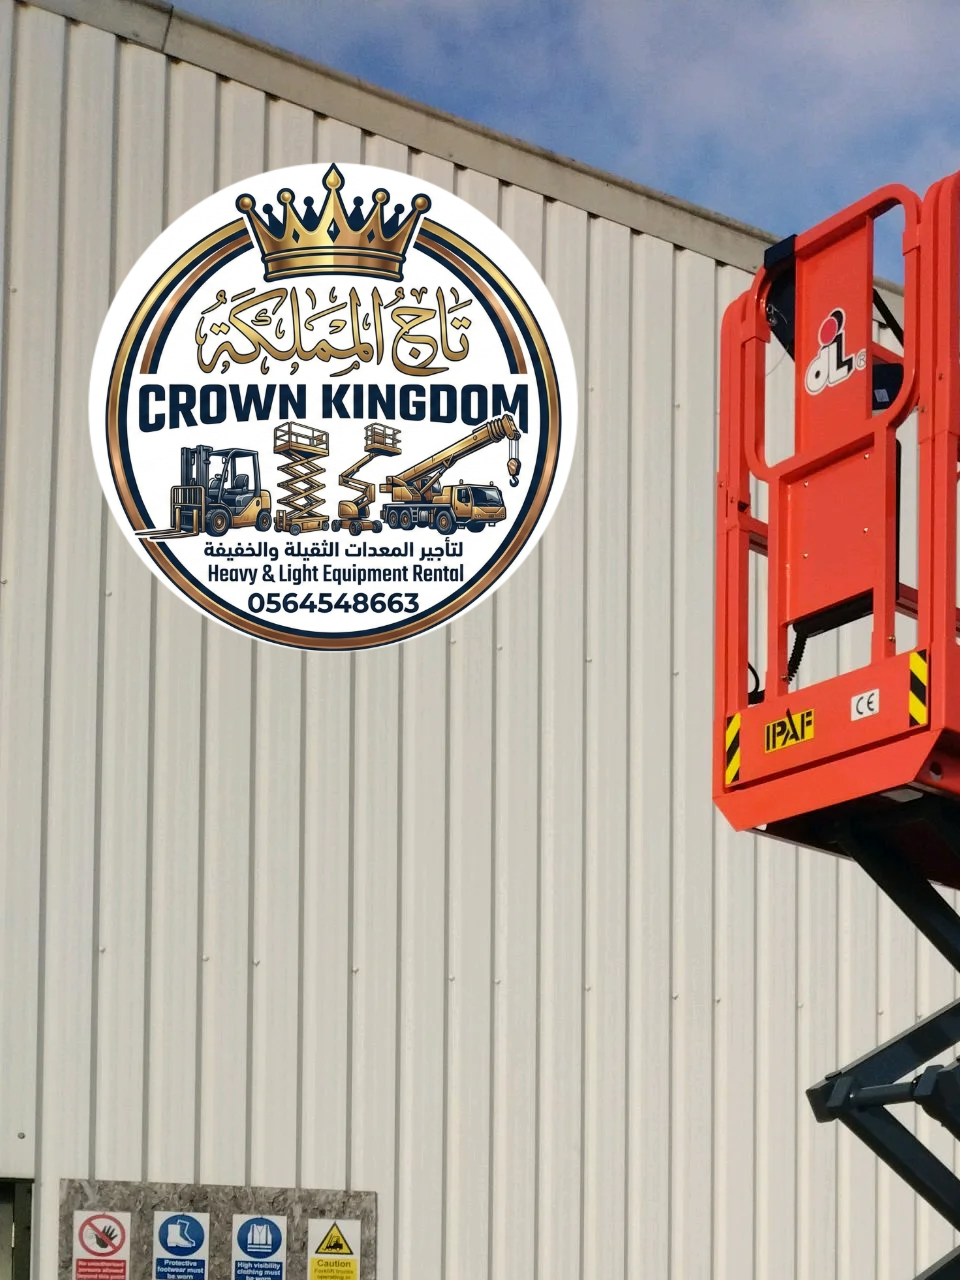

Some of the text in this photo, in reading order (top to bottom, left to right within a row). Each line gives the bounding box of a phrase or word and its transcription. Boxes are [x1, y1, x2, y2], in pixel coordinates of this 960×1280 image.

[765, 708, 813, 751] IPAF
[164, 1259, 197, 1267] Protective
[237, 1262, 281, 1271] High visibility
[317, 1259, 351, 1268] Caution
